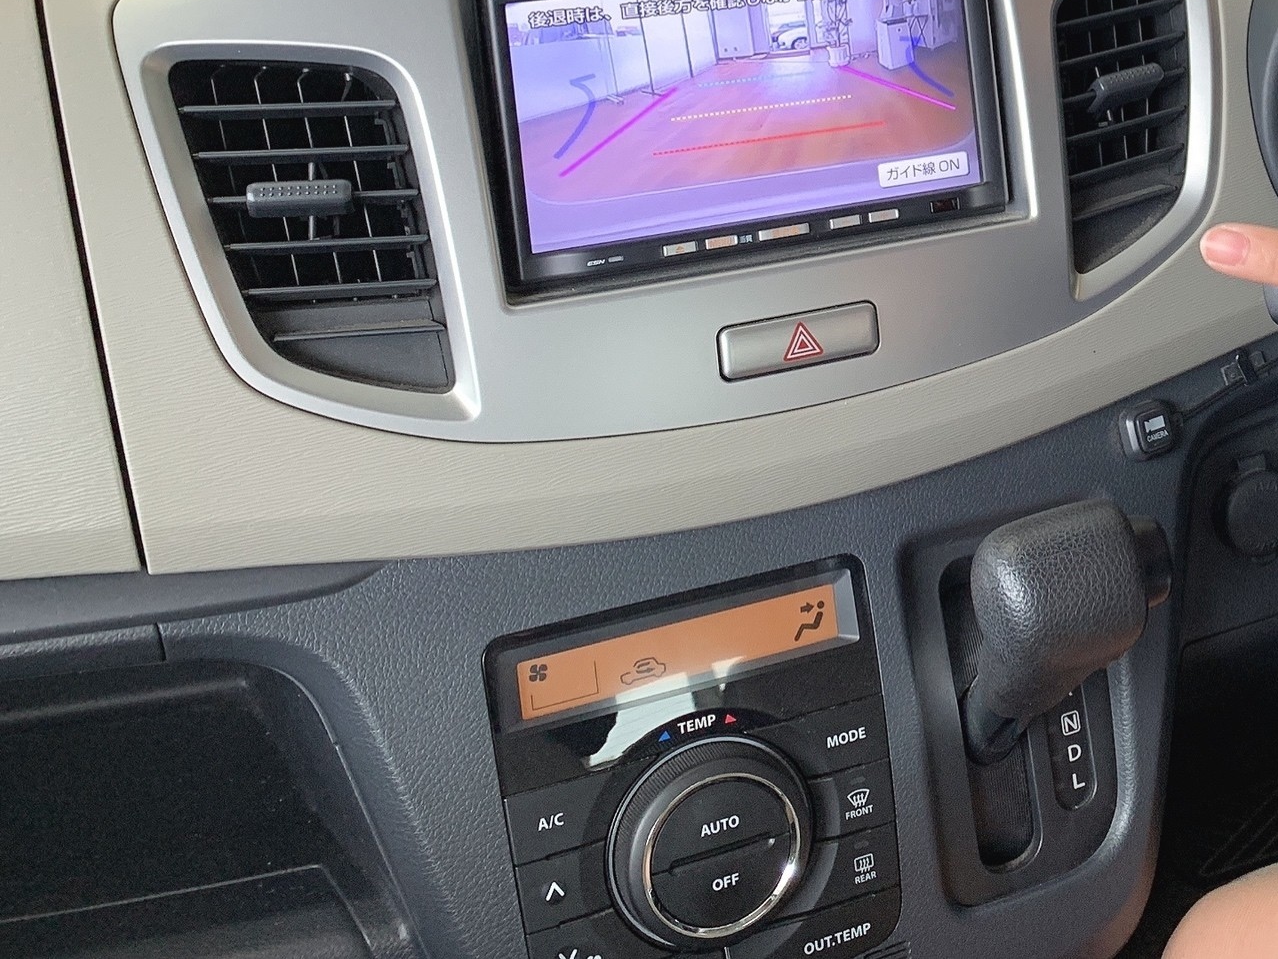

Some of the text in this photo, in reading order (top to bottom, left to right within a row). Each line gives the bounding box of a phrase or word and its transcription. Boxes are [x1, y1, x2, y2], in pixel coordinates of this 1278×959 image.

[887, 158, 961, 182] ガイド線 ON
[1146, 429, 1169, 443] CAMERA
[676, 714, 717, 735] TEMP
[1063, 714, 1079, 733] N
[826, 726, 868, 749] MODE
[1067, 743, 1082, 763] D
[1071, 772, 1086, 790] L
[537, 812, 565, 832] A/C
[844, 804, 875, 821] FRONT
[699, 815, 741, 839] AUTO
[711, 872, 741, 892] OFF
[854, 870, 877, 885] REAR
[803, 922, 872, 956] OUT.TEMP
